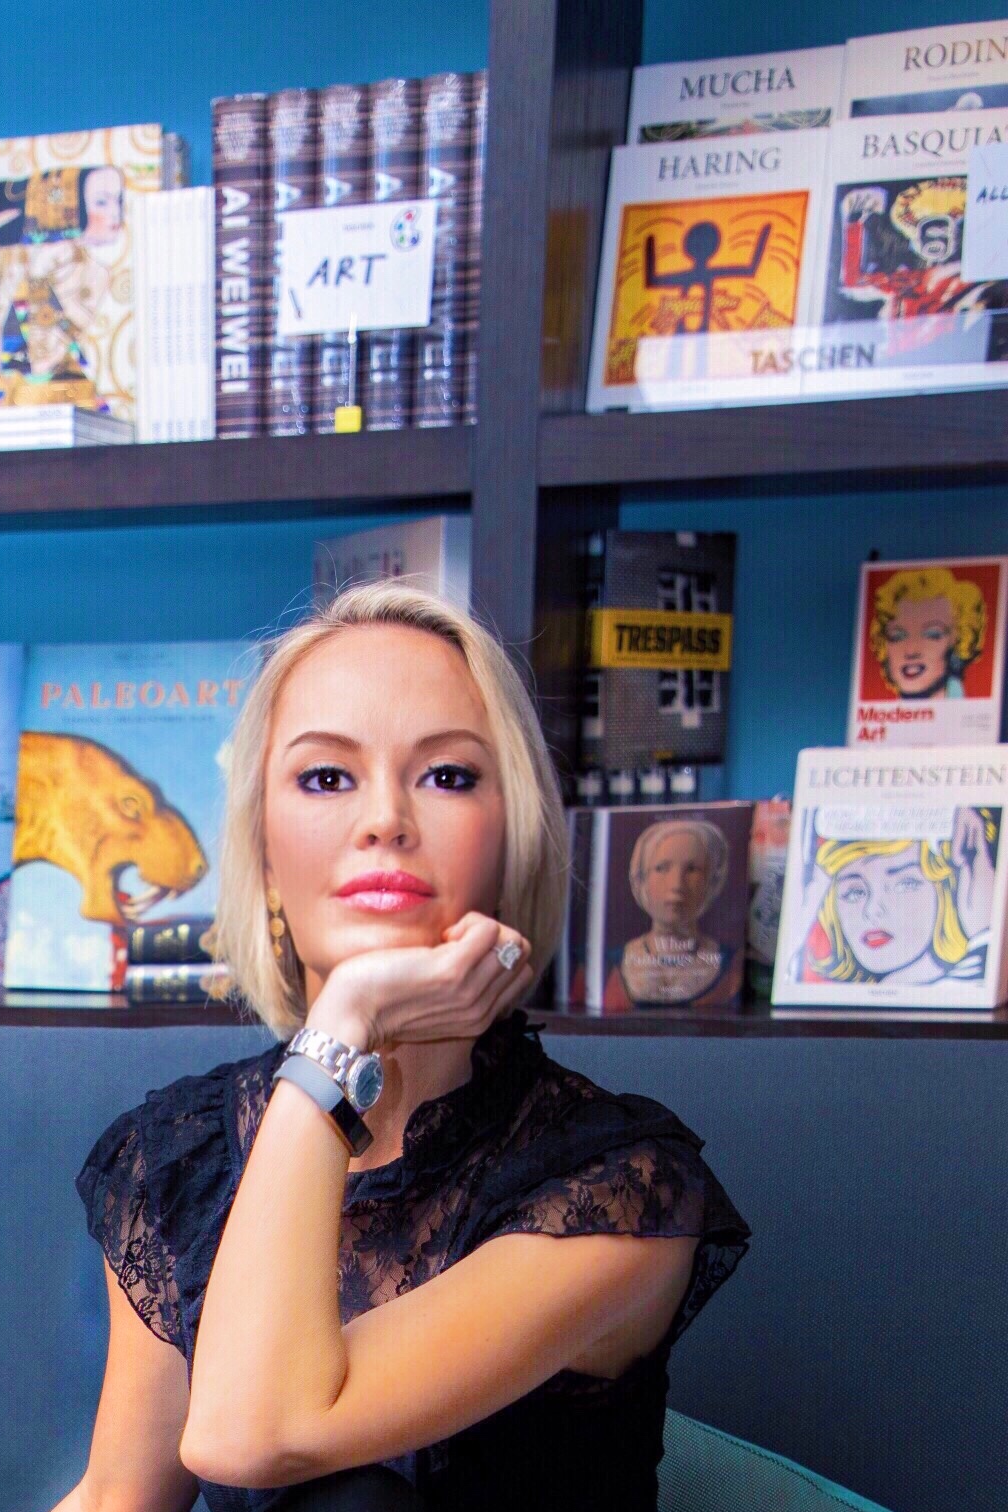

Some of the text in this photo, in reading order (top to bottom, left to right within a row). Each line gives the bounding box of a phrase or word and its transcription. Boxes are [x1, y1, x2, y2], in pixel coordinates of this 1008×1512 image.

[903, 35, 1008, 71] RODIN
[679, 66, 796, 101] MUCHA
[861, 124, 1008, 159] BASQUIA
[657, 147, 782, 182] HARING
[305, 253, 388, 287] ART
[220, 186, 251, 393] AI WEIWEI
[750, 342, 877, 375] TASCHEN
[614, 623, 722, 655] TRESPASS
[41, 677, 242, 710] PALEOART
[856, 706, 935, 724] Modern
[856, 726, 887, 742] Art
[807, 762, 1006, 789] LICHTENSTEIN
[654, 935, 697, 953] What
